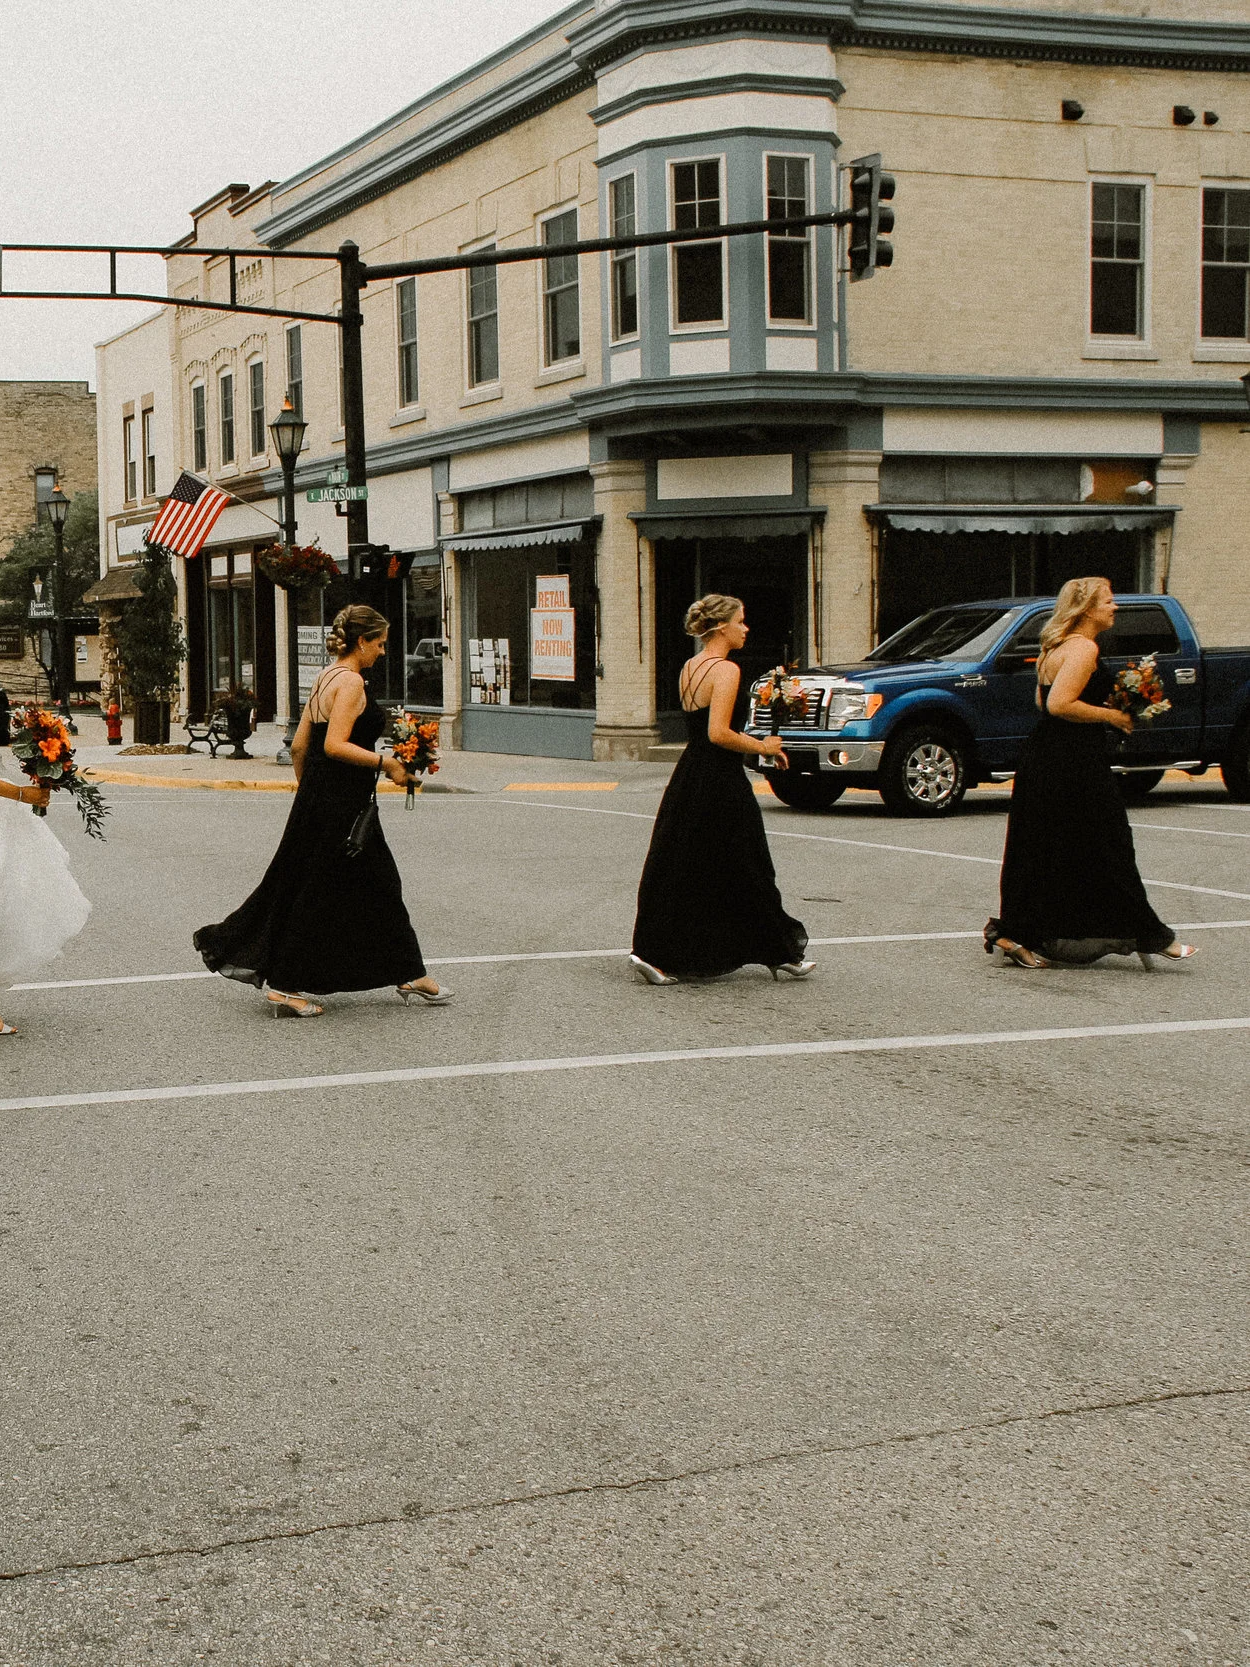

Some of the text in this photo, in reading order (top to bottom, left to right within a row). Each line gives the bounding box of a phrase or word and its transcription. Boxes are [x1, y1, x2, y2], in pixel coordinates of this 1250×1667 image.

[318, 487, 357, 501] JACKSON
[538, 591, 567, 608] RETAIL
[542, 619, 563, 635] NOW
[535, 640, 572, 657] RENTING
